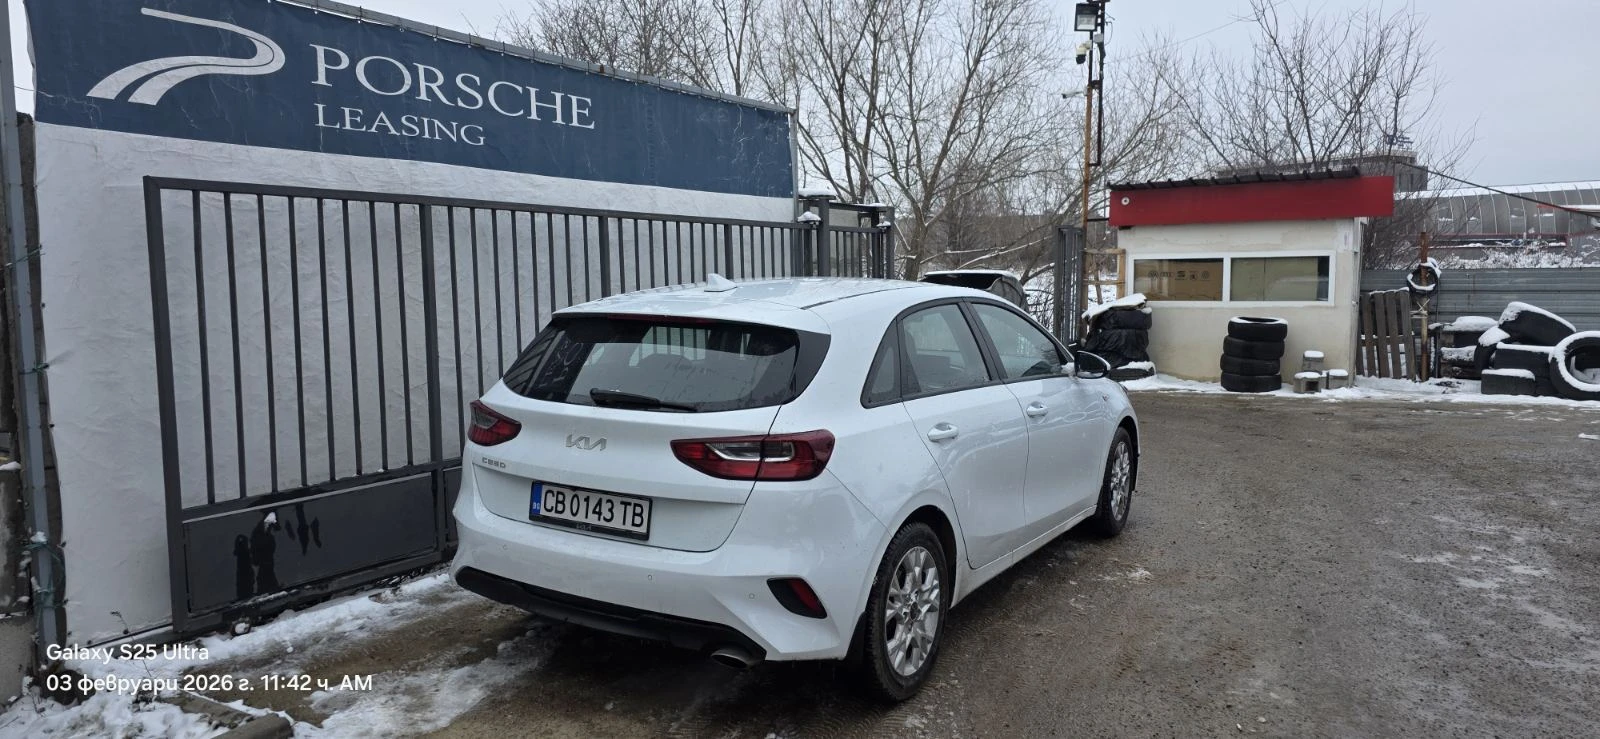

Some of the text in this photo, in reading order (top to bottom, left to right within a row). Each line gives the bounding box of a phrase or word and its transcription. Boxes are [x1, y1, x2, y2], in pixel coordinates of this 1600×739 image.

[310, 44, 596, 130] PORSCHE
[313, 103, 486, 146] LEASING
[543, 489, 645, 528] CB 0143 TB
